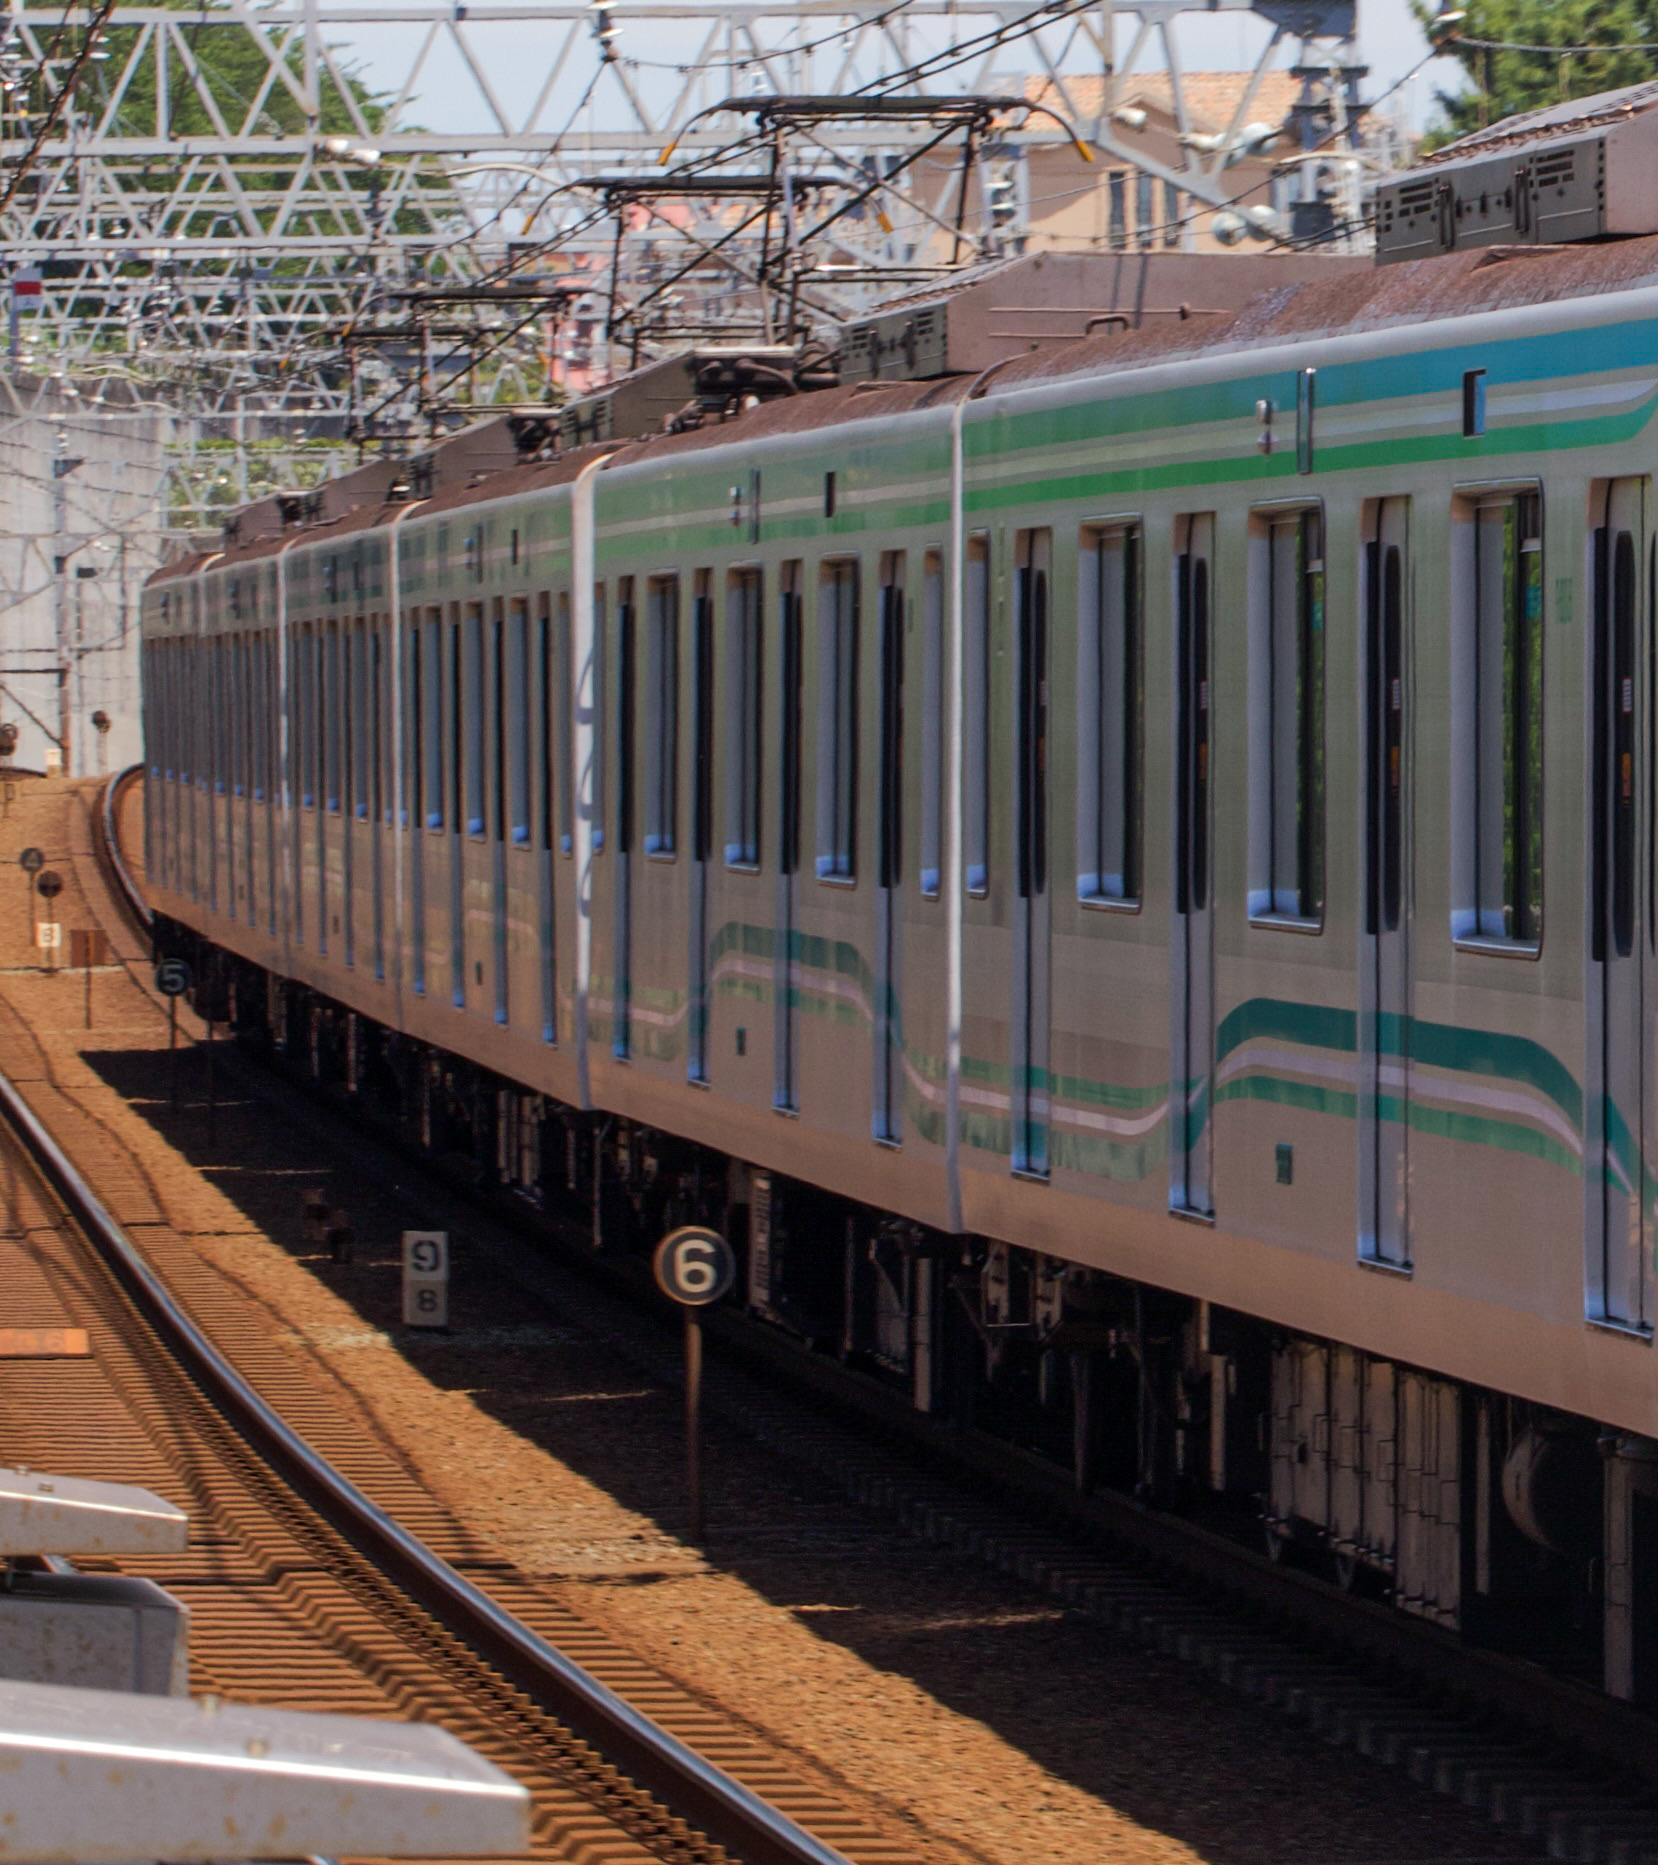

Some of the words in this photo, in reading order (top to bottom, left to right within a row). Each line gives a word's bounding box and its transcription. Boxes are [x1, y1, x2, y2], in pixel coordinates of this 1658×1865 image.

[162, 963, 185, 992] 5
[411, 1240, 440, 1273] 9
[673, 1238, 717, 1293] 6
